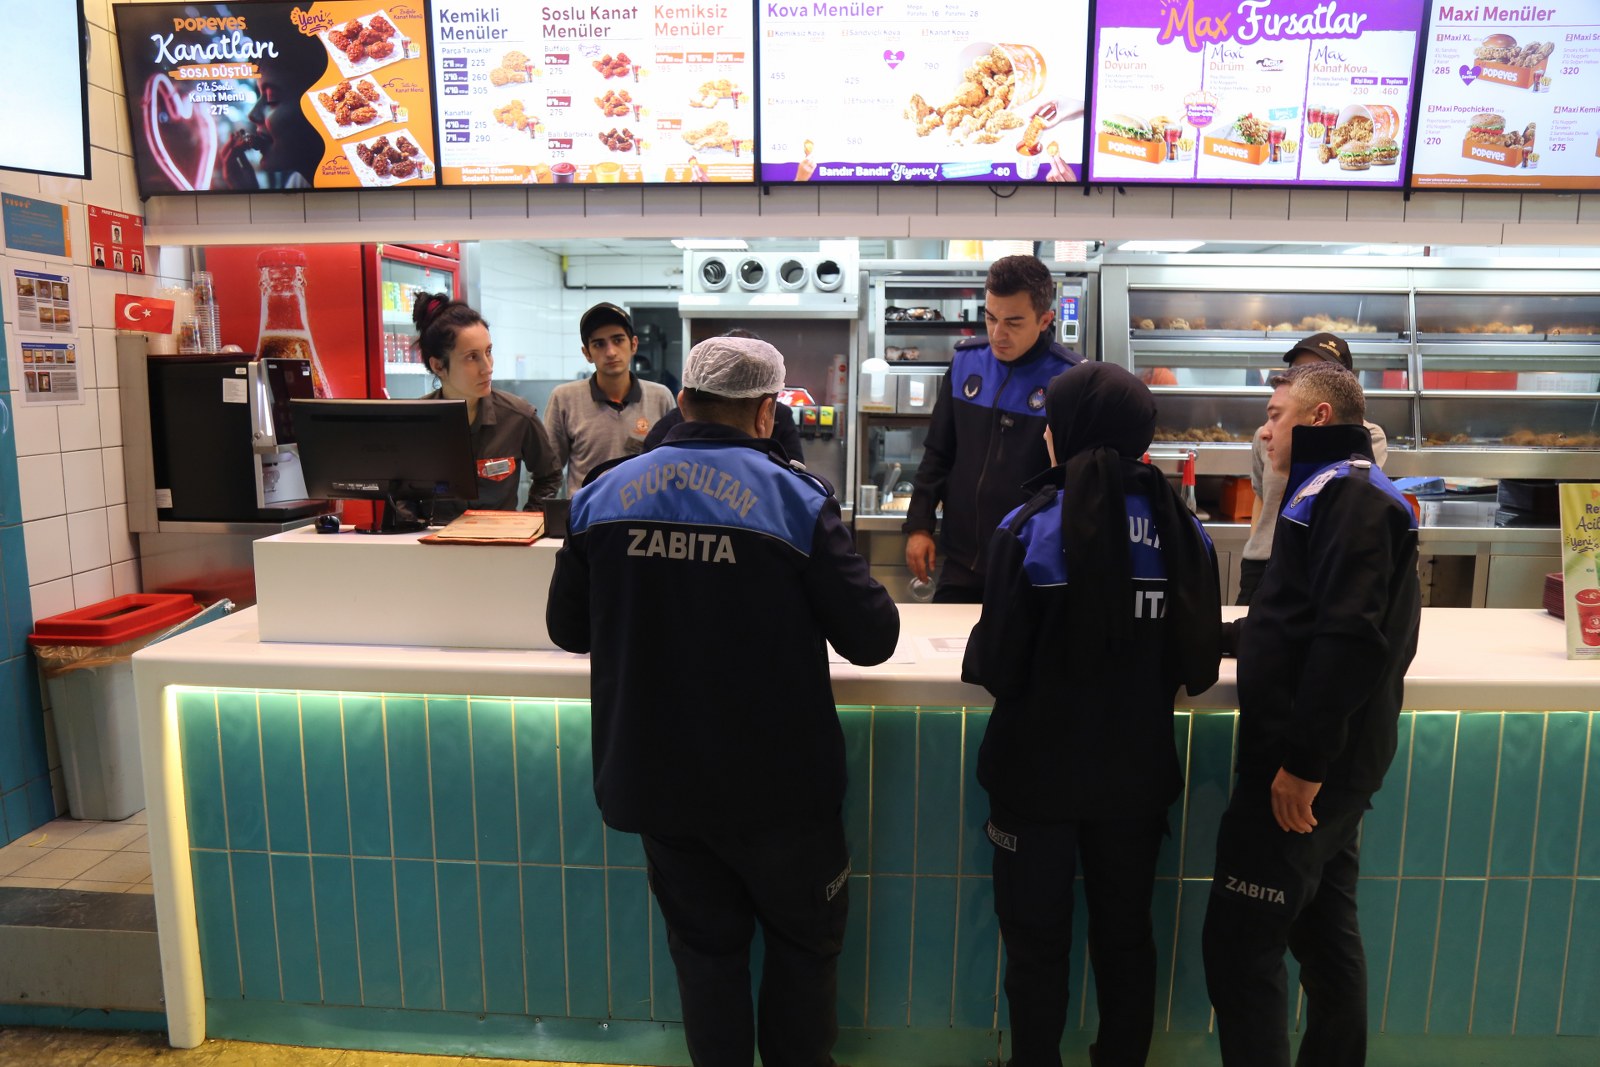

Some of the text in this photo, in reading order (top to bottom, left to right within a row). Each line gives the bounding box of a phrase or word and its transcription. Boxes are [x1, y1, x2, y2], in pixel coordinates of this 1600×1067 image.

[439, 8, 500, 24] Kemikli
[541, 6, 638, 21] Soslu Kanat
[654, 4, 728, 19] Kemiksiz
[768, 2, 884, 17] Kova Menüler
[1438, 6, 1556, 22] Maxi Menüler
[173, 16, 248, 32] POPEYES
[542, 23, 611, 38] Menüler
[655, 22, 724, 36] Menüler
[1162, 1, 1367, 47] Max Fırsatlar
[440, 25, 509, 41] Menüler
[151, 31, 279, 65] Kanatları
[1105, 42, 1139, 61] Maxi
[1210, 44, 1245, 62] Maxi
[1314, 45, 1348, 64] Max
[179, 65, 253, 78] SOSA DÜŞTÜ!
[1104, 61, 1147, 71] Doyuran
[1209, 61, 1244, 71] Dürüm
[1312, 64, 1368, 74] Kanat Kova
[1434, 66, 1450, 74] 285
[1563, 66, 1580, 74] 320
[1482, 66, 1518, 82] POPEYES
[211, 81, 234, 92] Soslu
[189, 91, 245, 103] Kanat Menü
[210, 105, 229, 116] 275
[1453, 106, 1494, 114] Popchicken
[1108, 142, 1146, 158] POPEYES
[1212, 144, 1248, 158] POPEYES
[1472, 147, 1505, 162] POPEYES
[1552, 144, 1566, 152] 275
[819, 167, 854, 176] Bandır
[856, 166, 891, 176] Bandır
[619, 461, 759, 518] EYÜPSULTAN
[627, 528, 736, 564] ZABITA
[1225, 876, 1285, 904] ZABITA
